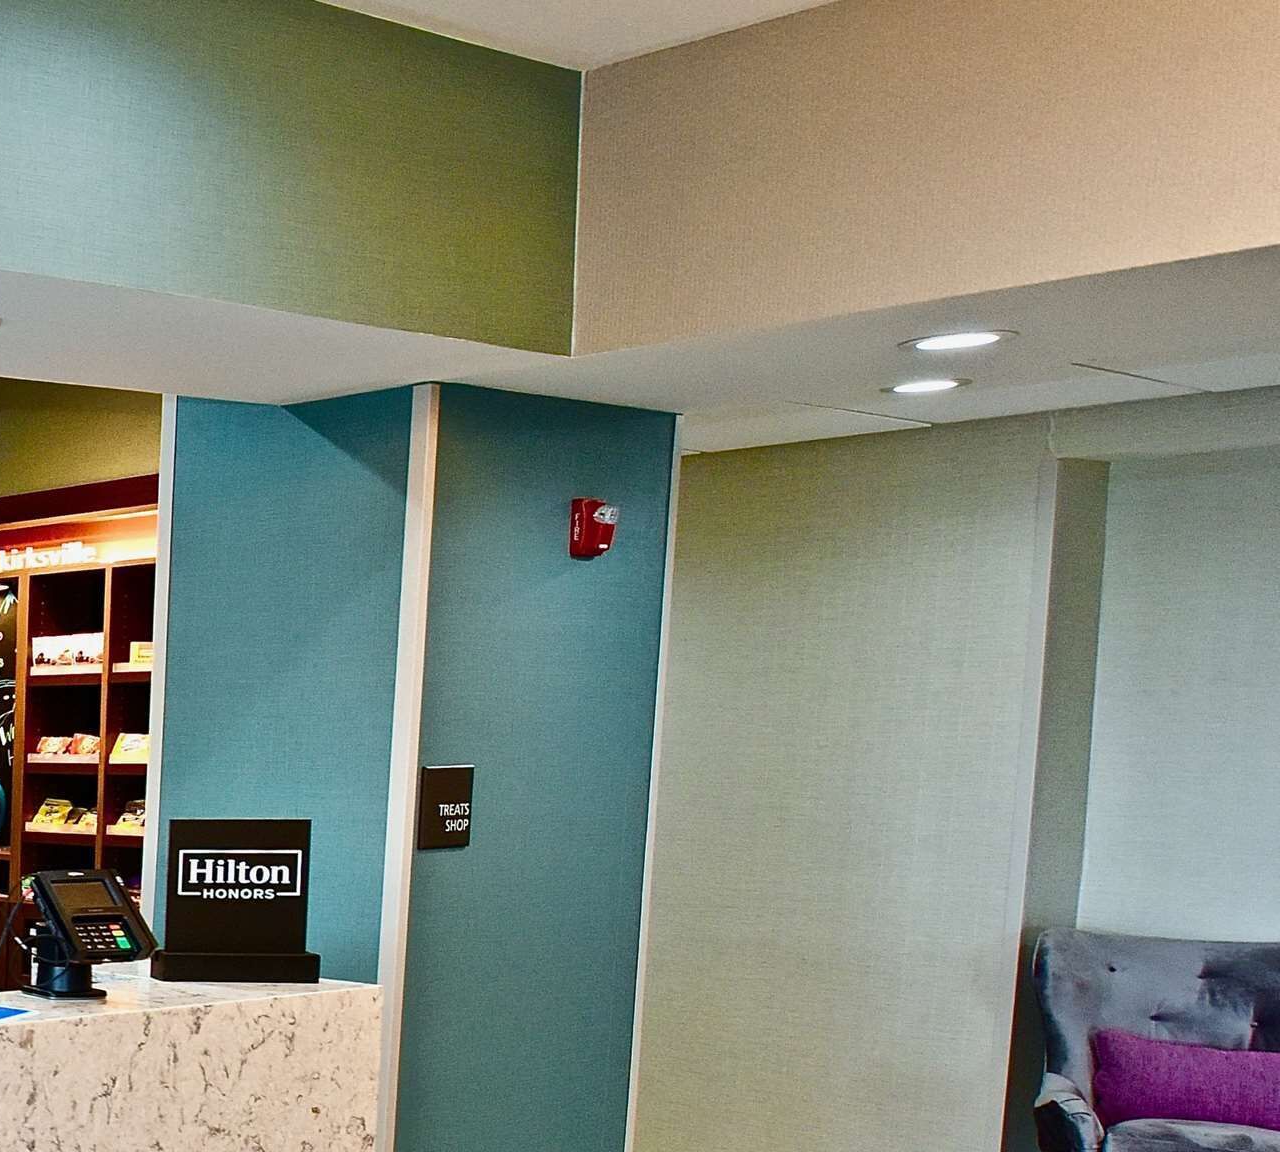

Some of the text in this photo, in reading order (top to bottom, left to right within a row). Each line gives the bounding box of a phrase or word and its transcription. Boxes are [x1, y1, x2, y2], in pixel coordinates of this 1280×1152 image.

[573, 512, 581, 540] FIRE
[439, 802, 470, 816] TREATS
[445, 818, 469, 832] SHOP
[188, 858, 291, 884] Hilton
[202, 888, 275, 900] HONORS
